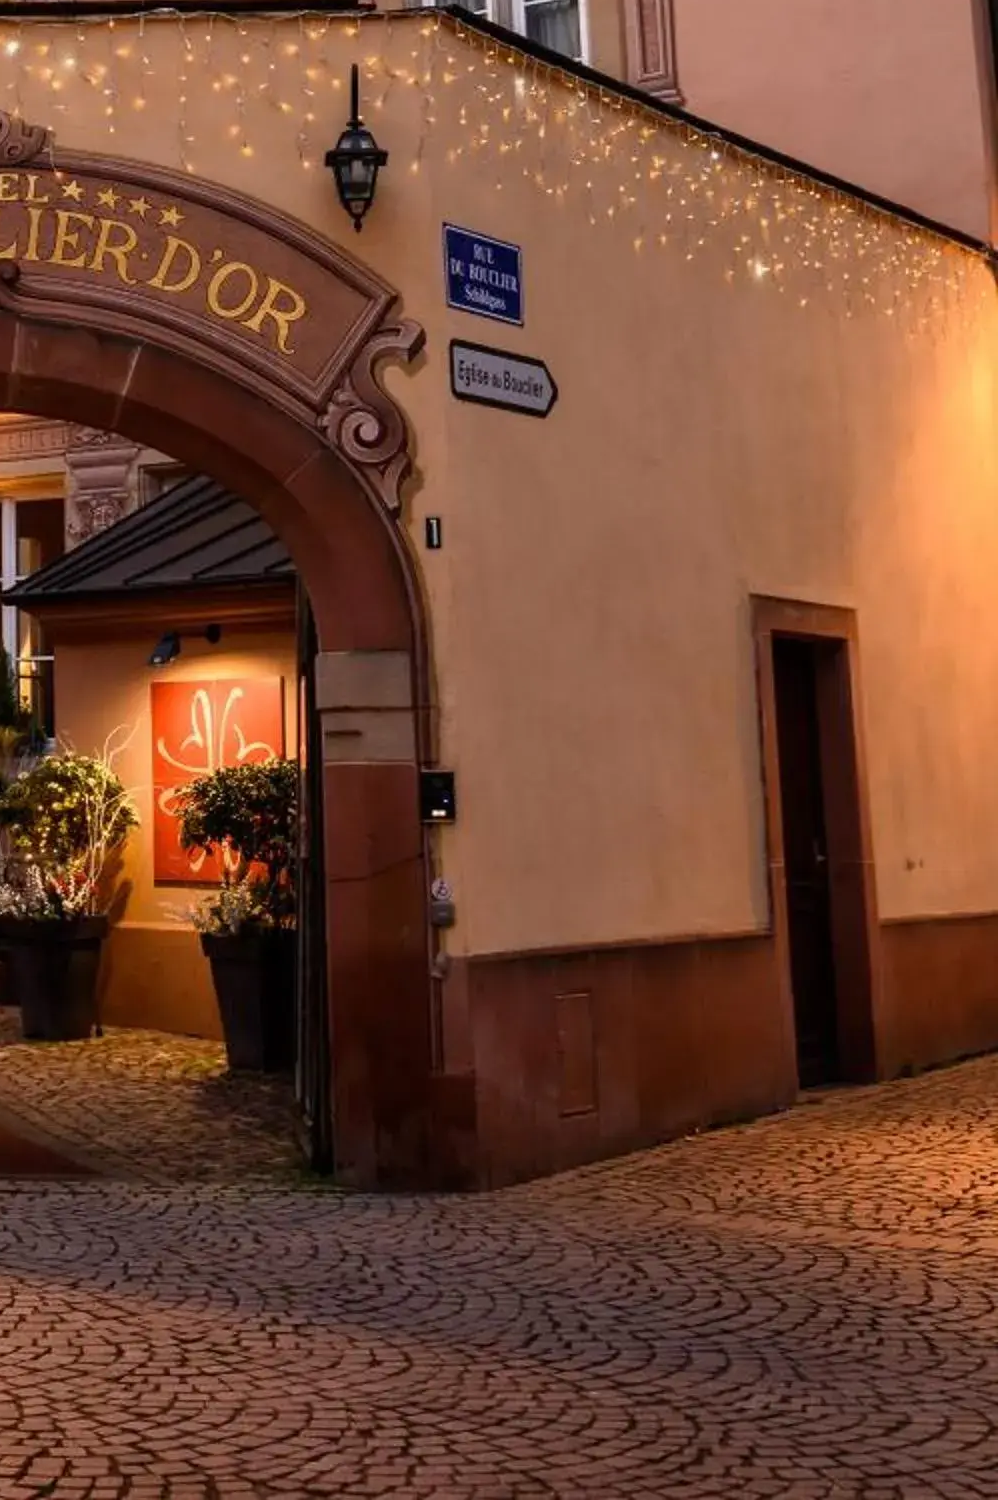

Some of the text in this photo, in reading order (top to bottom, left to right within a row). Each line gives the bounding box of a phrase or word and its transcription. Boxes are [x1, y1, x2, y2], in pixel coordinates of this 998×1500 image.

[469, 263, 518, 293] BOUCLIER
[145, 235, 307, 355] D'OR
[503, 370, 544, 398] Bouclier
